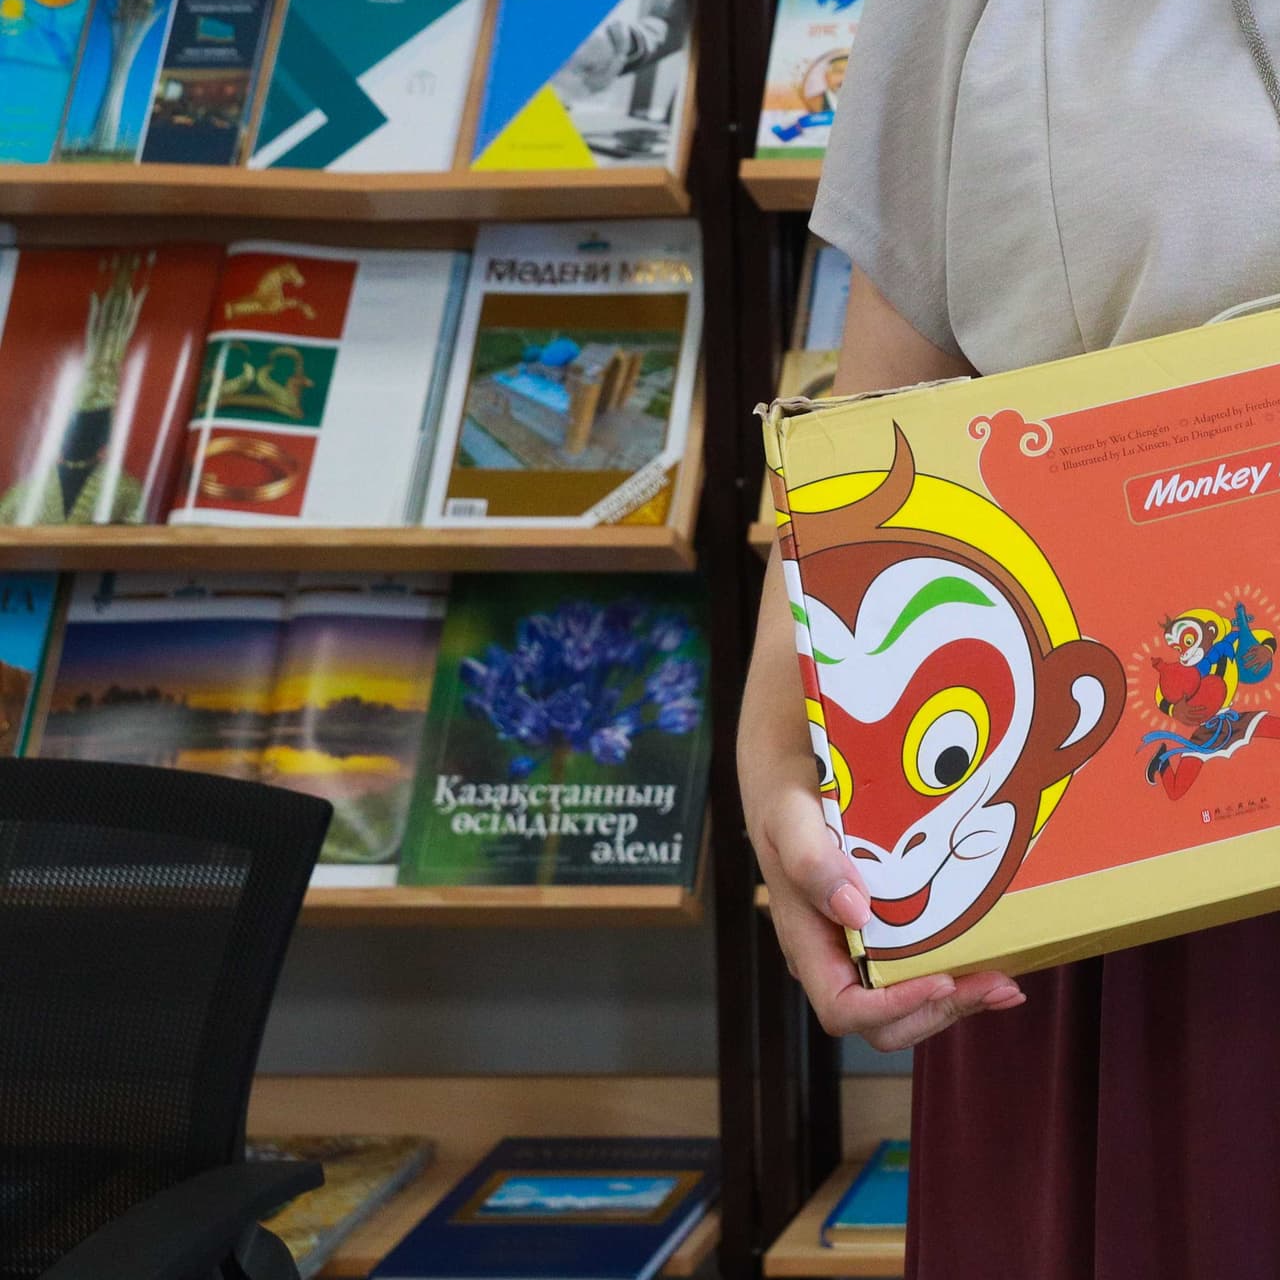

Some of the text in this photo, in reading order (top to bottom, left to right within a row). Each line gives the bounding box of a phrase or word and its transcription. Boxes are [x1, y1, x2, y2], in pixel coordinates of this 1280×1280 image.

[1193, 407, 1231, 425] Adapted
[1232, 405, 1244, 419] by
[1059, 441, 1095, 457] Written
[1096, 437, 1108, 450] by
[1109, 433, 1127, 445] Wu
[1062, 452, 1108, 471] Illustrated
[1109, 449, 1121, 462] by
[1172, 432, 1190, 445] Yan
[1191, 423, 1232, 441] Dingxian
[1232, 422, 1243, 431] et
[1143, 461, 1274, 511] Monkey
[433, 774, 677, 814] Қазақстанның
[451, 811, 639, 840] өсімдіктер
[590, 833, 684, 864] әлемі
